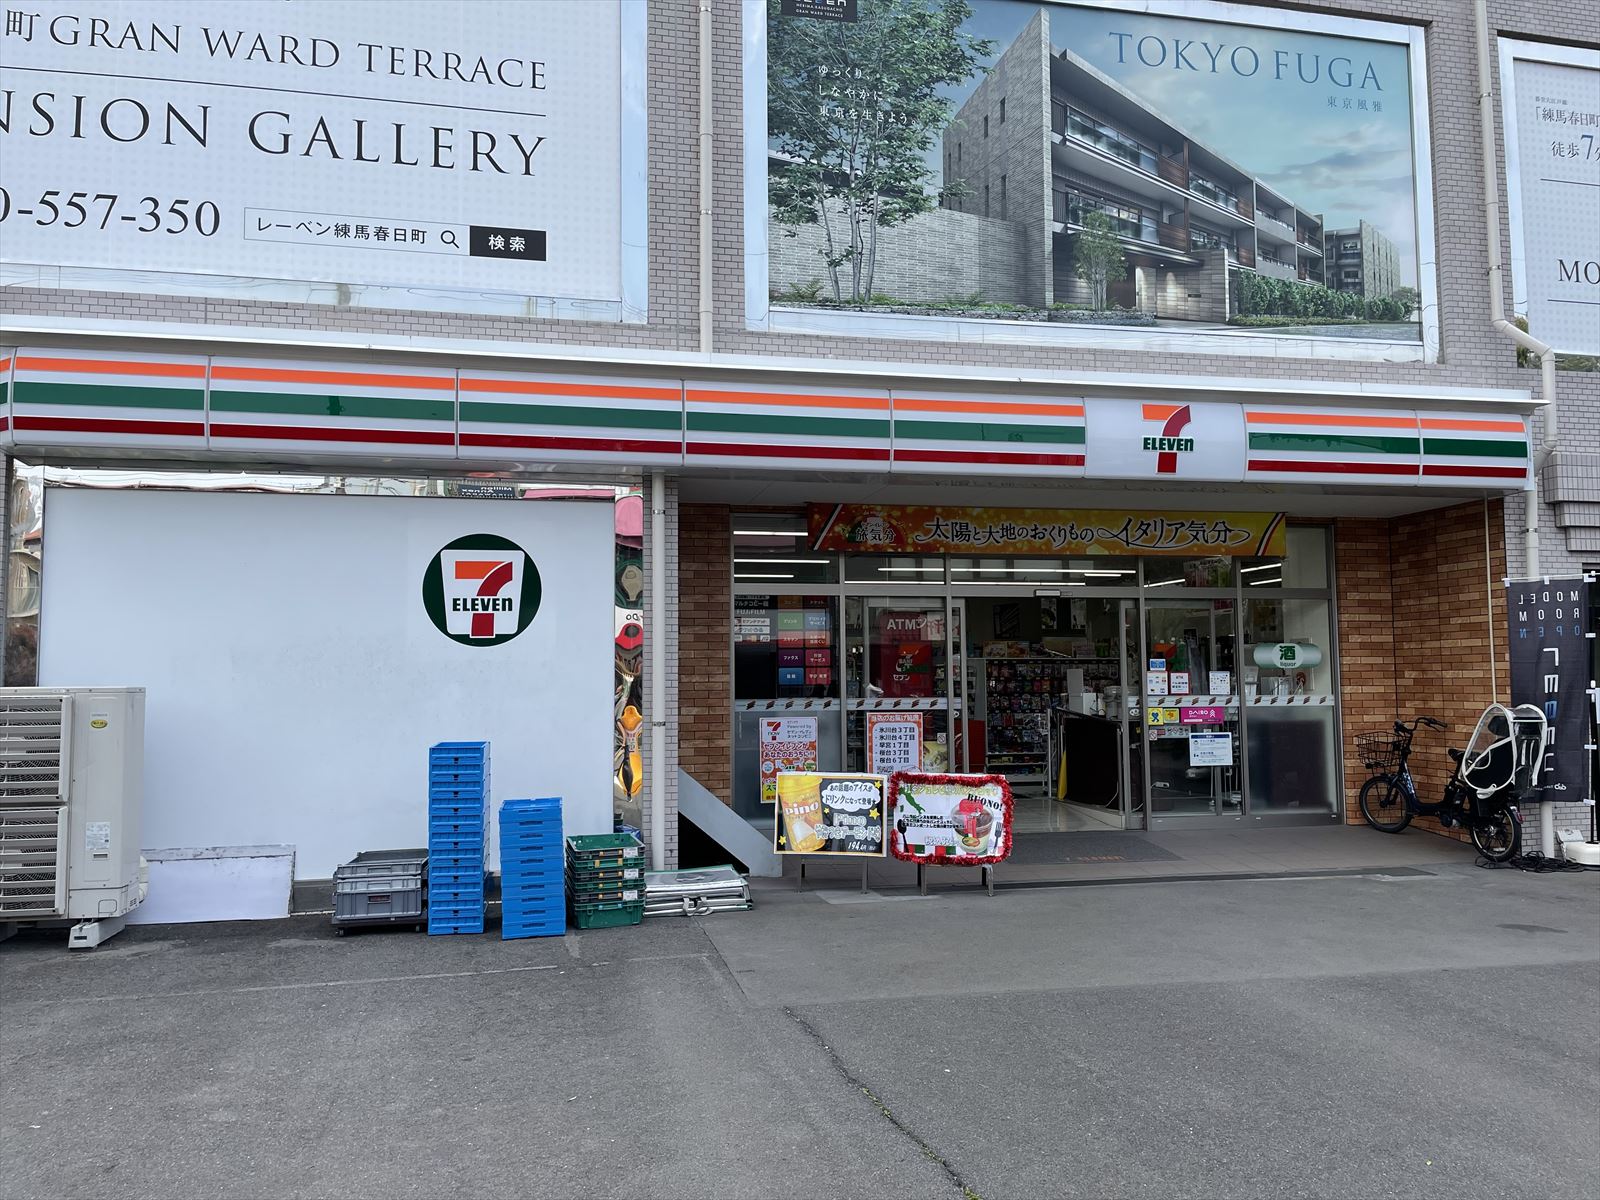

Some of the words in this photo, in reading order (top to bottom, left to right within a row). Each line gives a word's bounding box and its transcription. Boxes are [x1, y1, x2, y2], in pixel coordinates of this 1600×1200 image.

[5, 10, 40, 42] 町
[50, 15, 182, 54] GRAN
[203, 27, 340, 69] WARD
[358, 43, 547, 91] TERRACE
[1109, 31, 1260, 77] TOKYO
[1275, 49, 1384, 92] FUGA
[818, 65, 870, 80] ゆっくり、
[819, 85, 883, 101] しなやかに
[1327, 95, 1384, 113] 東京風雅
[819, 105, 915, 125] 東京を生きよう。
[0, 88, 212, 149] SION
[247, 109, 546, 177] GALLERY
[256, 216, 427, 246] レーベン練馬春日町
[487, 234, 526, 253] 検索
[1141, 404, 1192, 473] 7
[855, 528, 898, 545] 旅気分
[454, 560, 513, 638] 7
[887, 618, 916, 630] ATM
[1279, 645, 1296, 661] 酒
